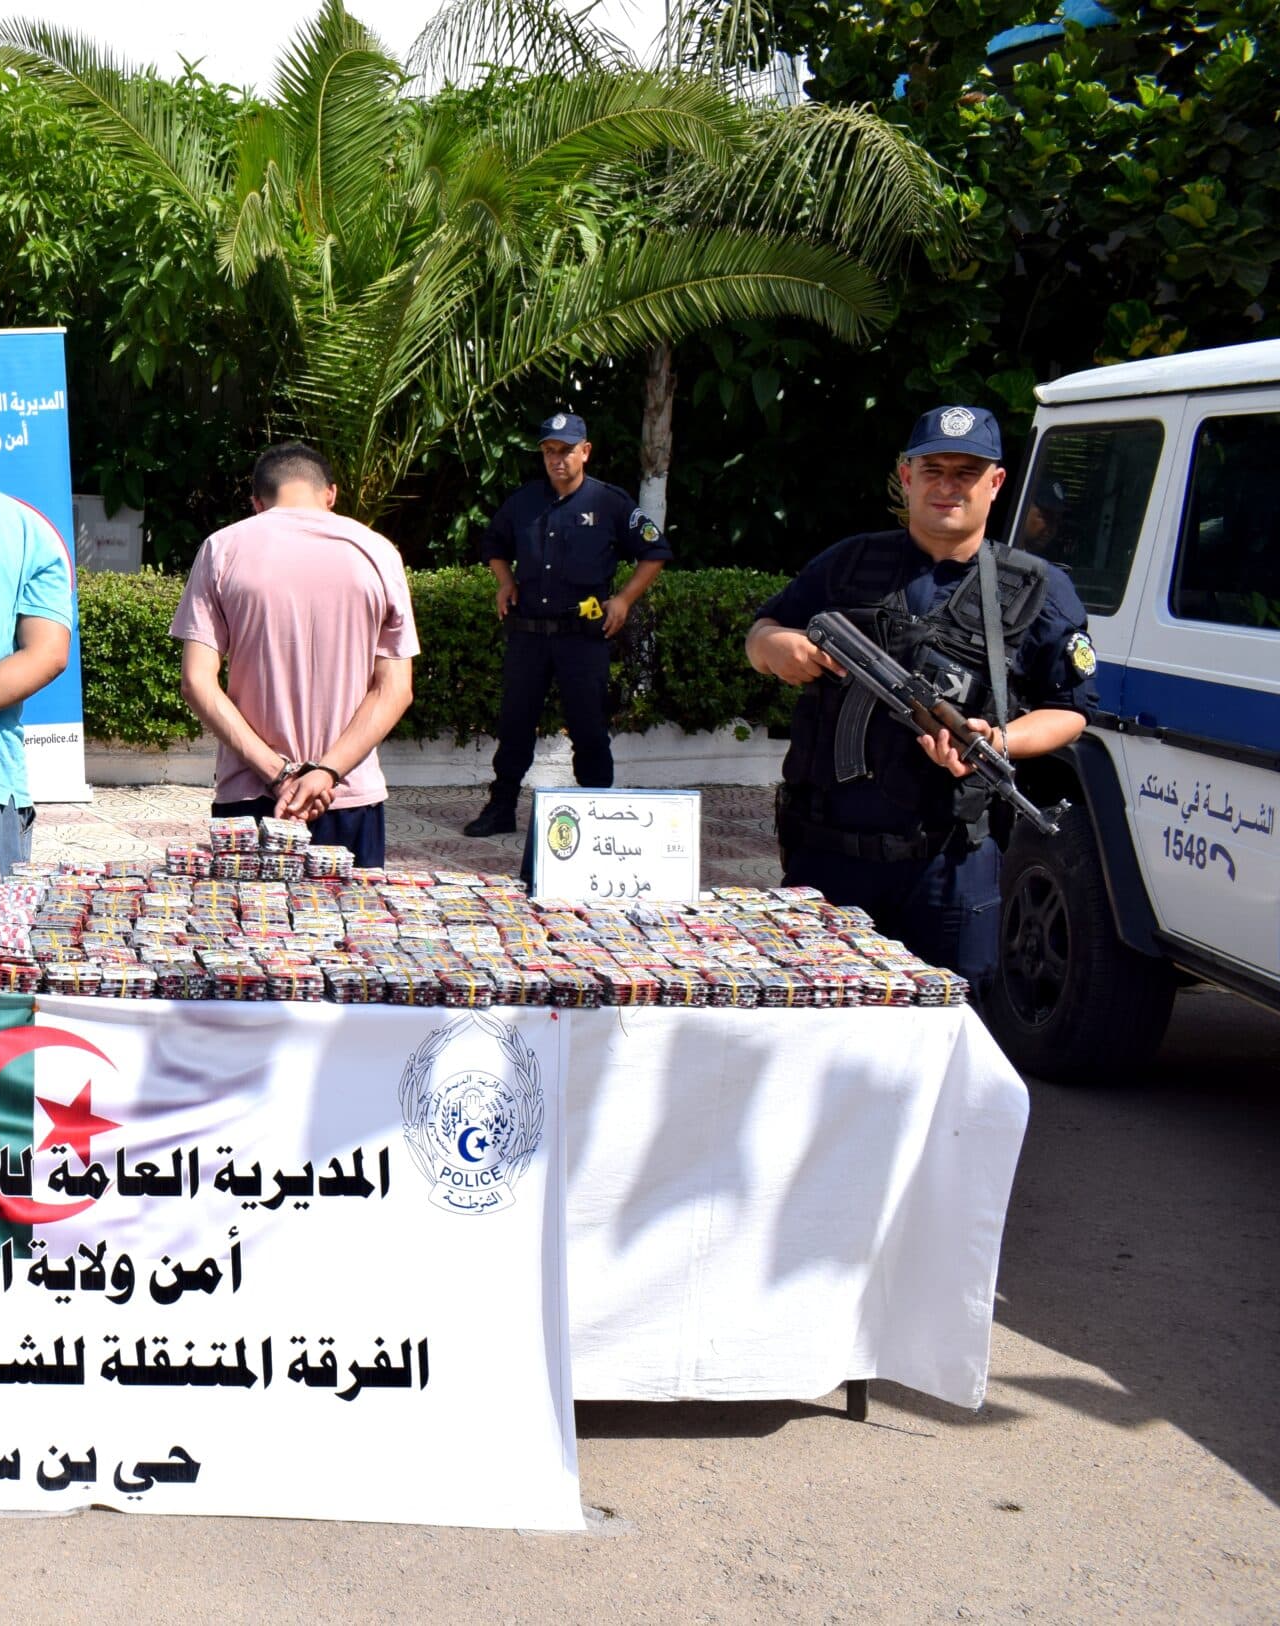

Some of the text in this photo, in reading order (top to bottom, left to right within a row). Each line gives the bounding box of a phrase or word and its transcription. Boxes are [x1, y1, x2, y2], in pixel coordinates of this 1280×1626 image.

[10, 390, 65, 416] المديرية
[4, 420, 29, 451] أمن
[22, 732, 79, 748] eriepolice.dz
[587, 801, 654, 827] رخصة
[1138, 773, 1275, 835] الشرطة في خدمتكم
[593, 836, 642, 861] سياقة
[1163, 826, 1207, 869] 1548
[590, 874, 652, 897] مزورة
[47, 1144, 200, 1199] العامة
[214, 1144, 390, 1210] المديرية
[439, 1165, 504, 1188] POLICE
[26, 1238, 136, 1305] ولاية
[148, 1225, 243, 1305] أمن
[100, 1334, 273, 1390] المتنقلة
[287, 1335, 429, 1402] الفرقة
[36, 1444, 98, 1490] بن
[112, 1444, 201, 1501] حي
